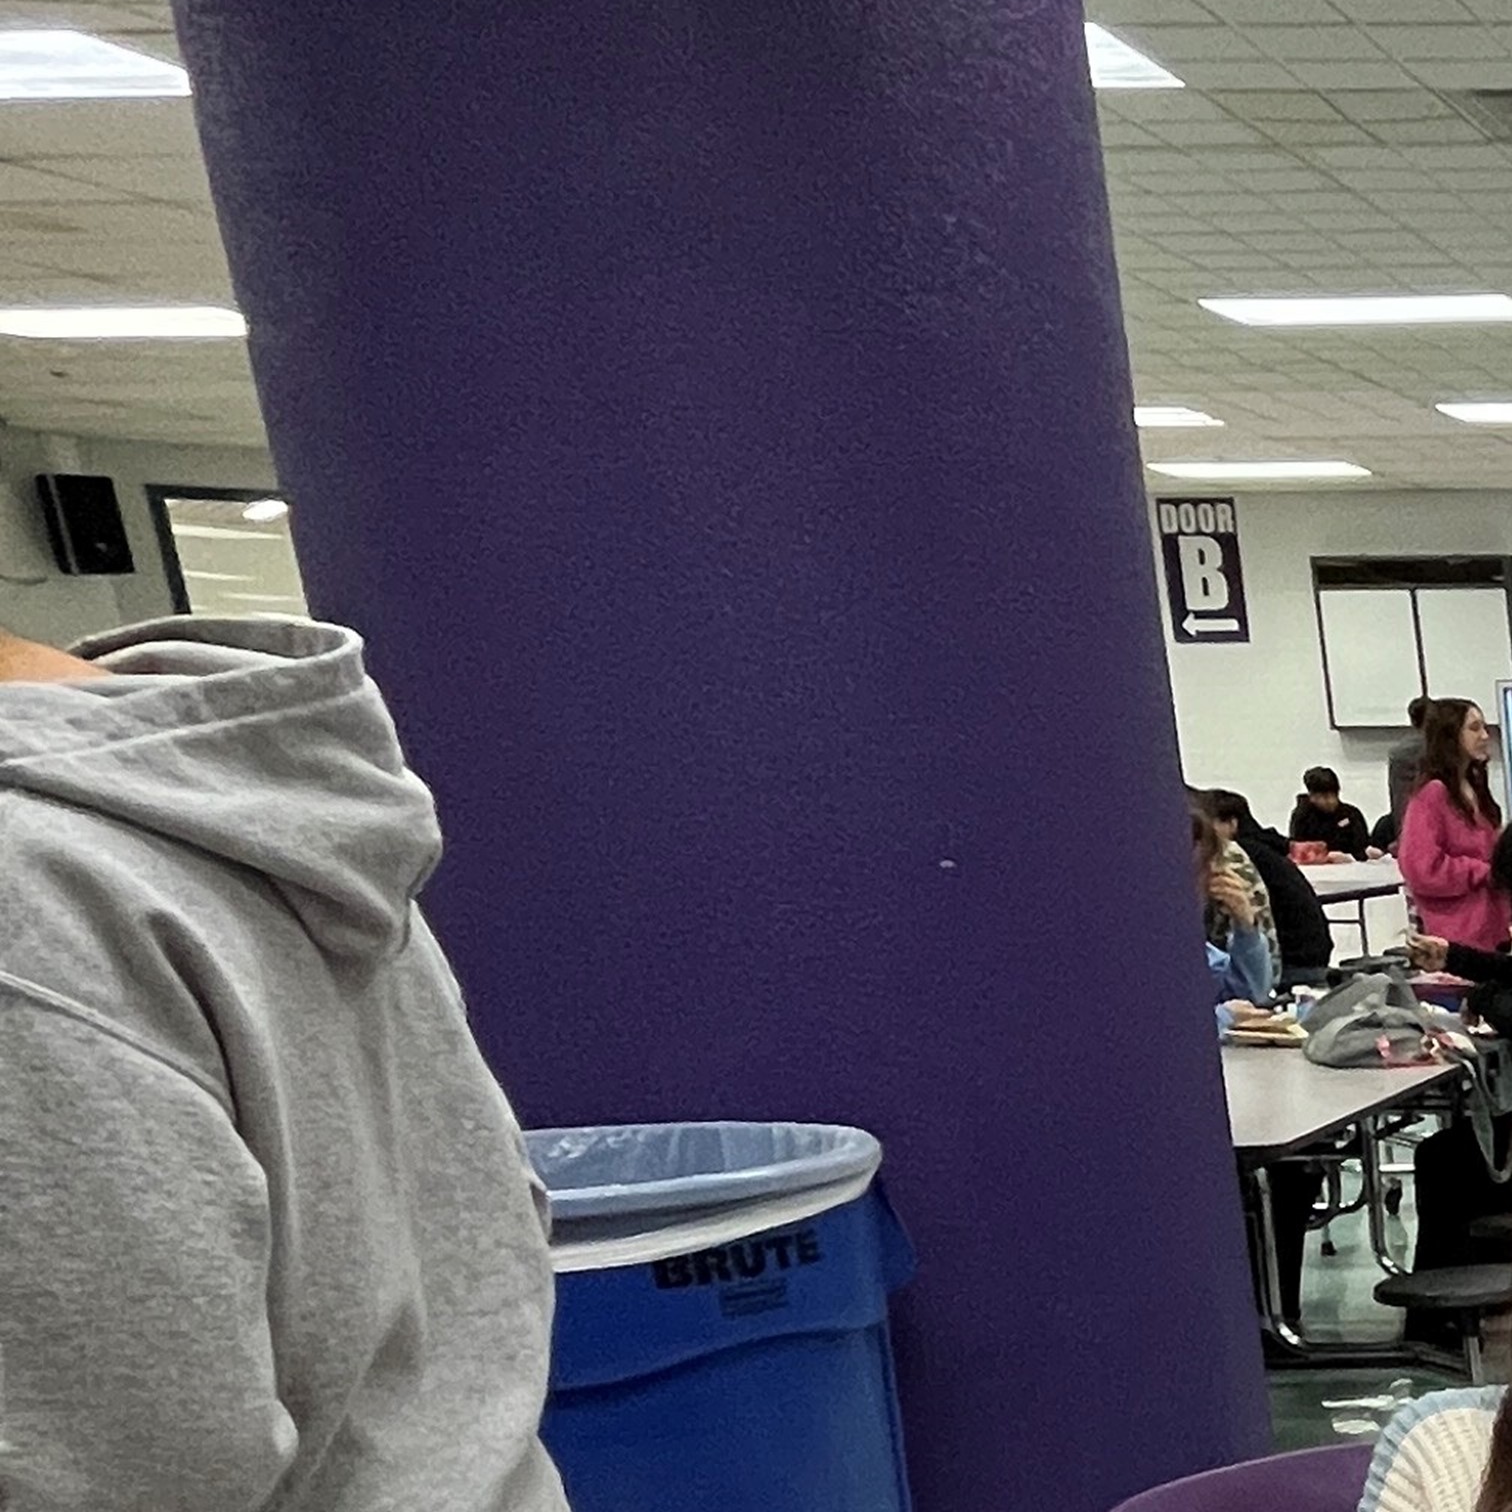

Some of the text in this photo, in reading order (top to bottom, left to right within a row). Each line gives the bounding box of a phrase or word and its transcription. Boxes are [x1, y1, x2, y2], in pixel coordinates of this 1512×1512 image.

[1159, 503, 1234, 534] DOOR
[1178, 535, 1229, 611] B
[653, 1228, 821, 1289] BRUTE
